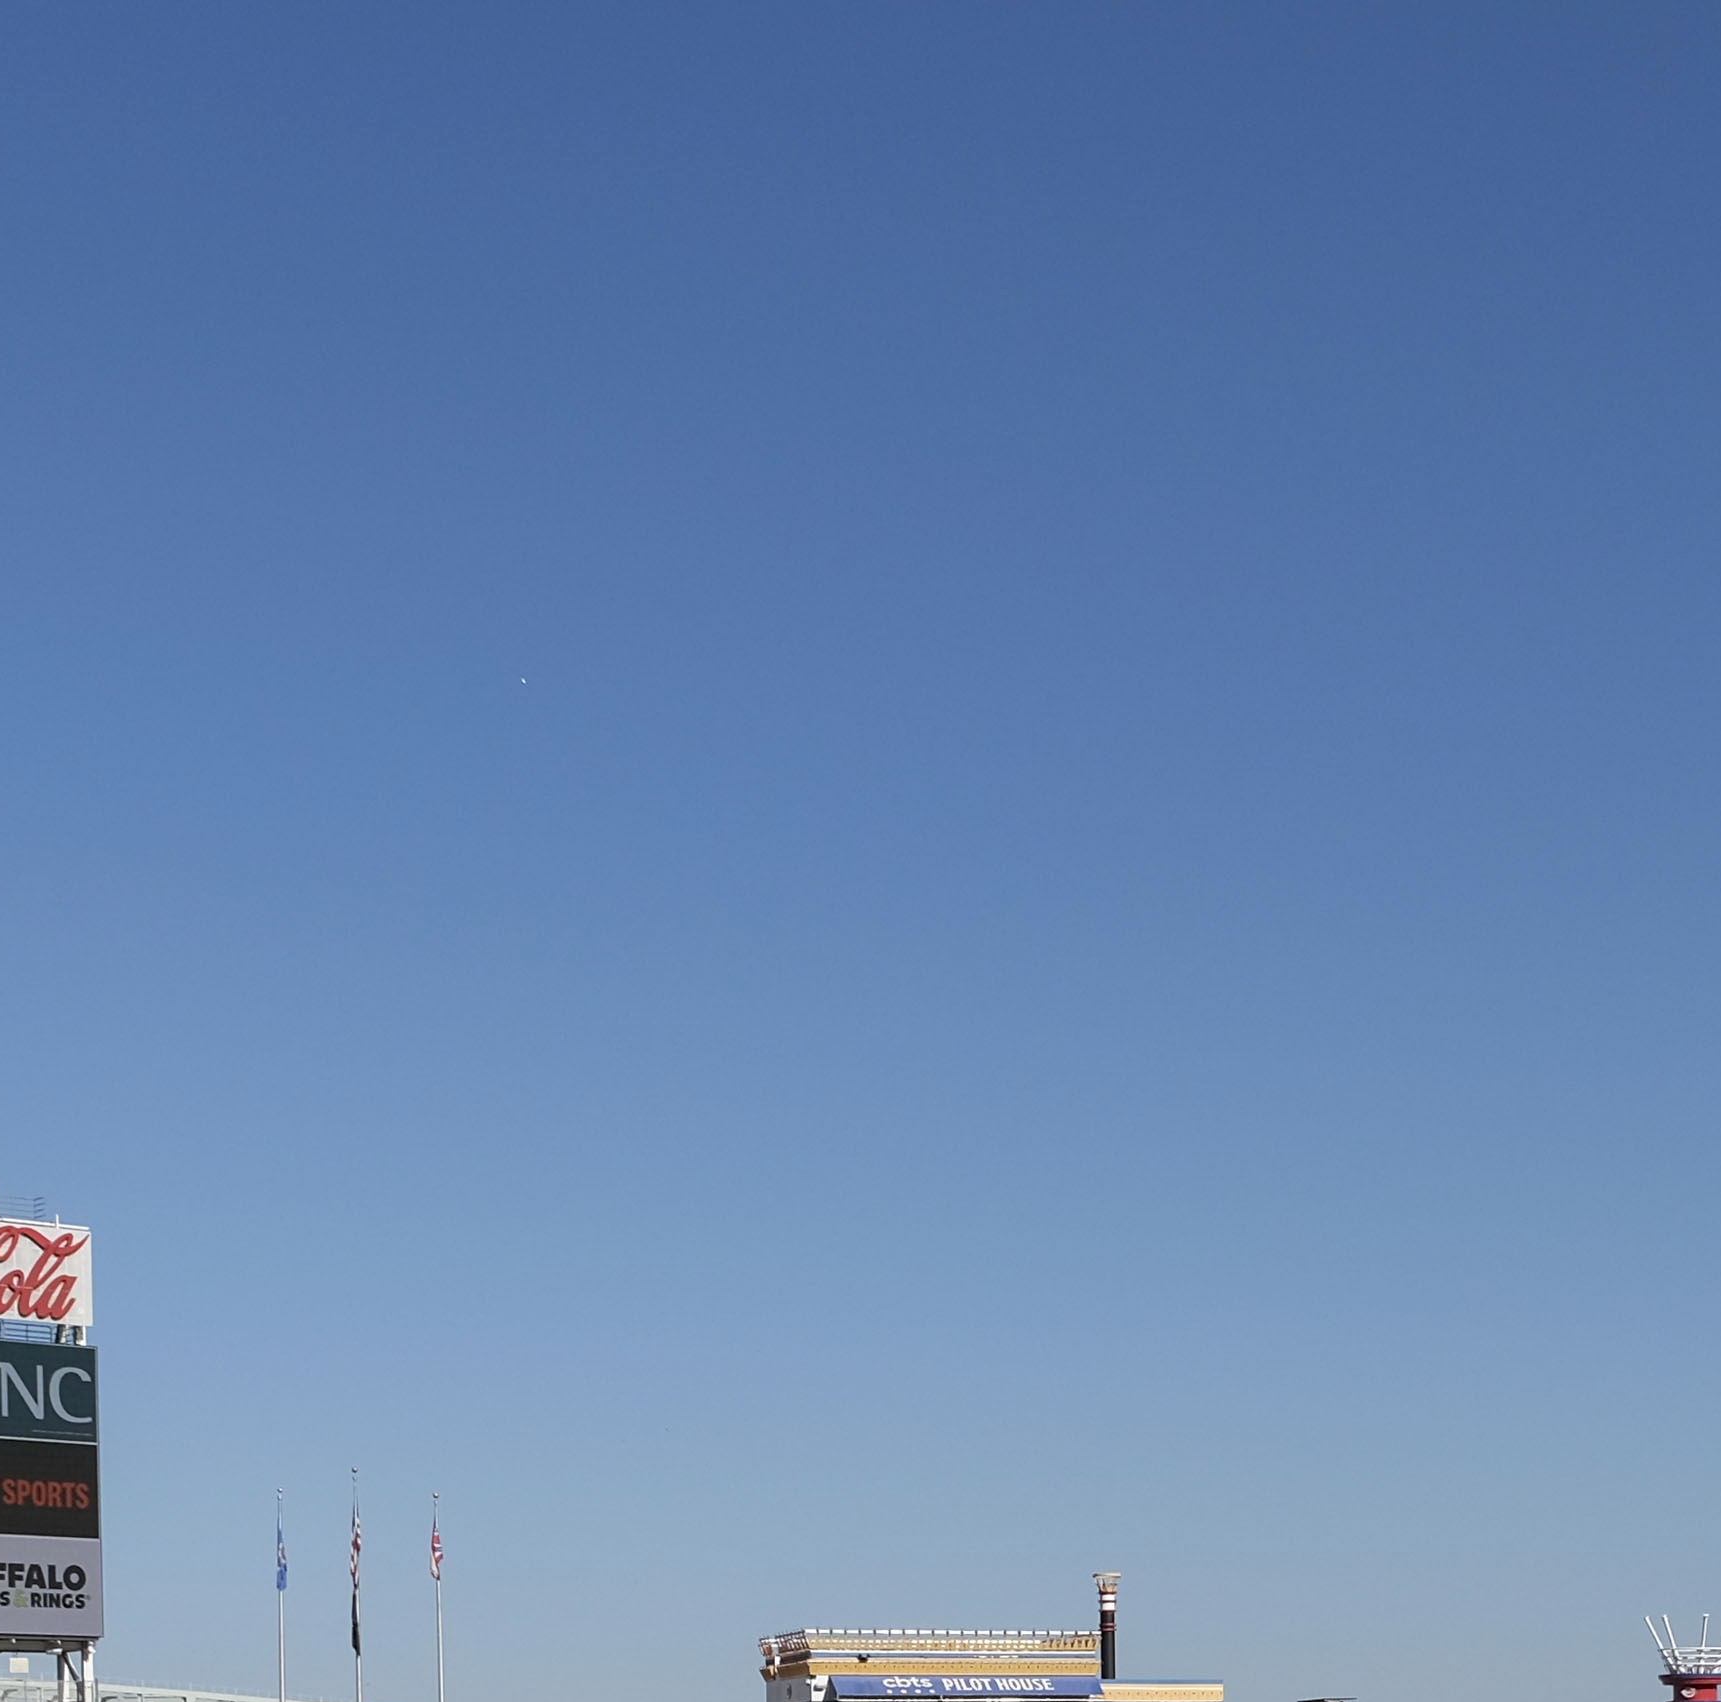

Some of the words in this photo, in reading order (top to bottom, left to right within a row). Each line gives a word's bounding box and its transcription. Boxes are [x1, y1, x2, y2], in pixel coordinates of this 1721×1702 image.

[3, 1478, 90, 1509] SPORTS
[30, 1593, 86, 1609] RINGS
[883, 1676, 933, 1690] cbts
[942, 1678, 991, 1692] PILOT
[995, 1677, 1054, 1692] HOUSE
